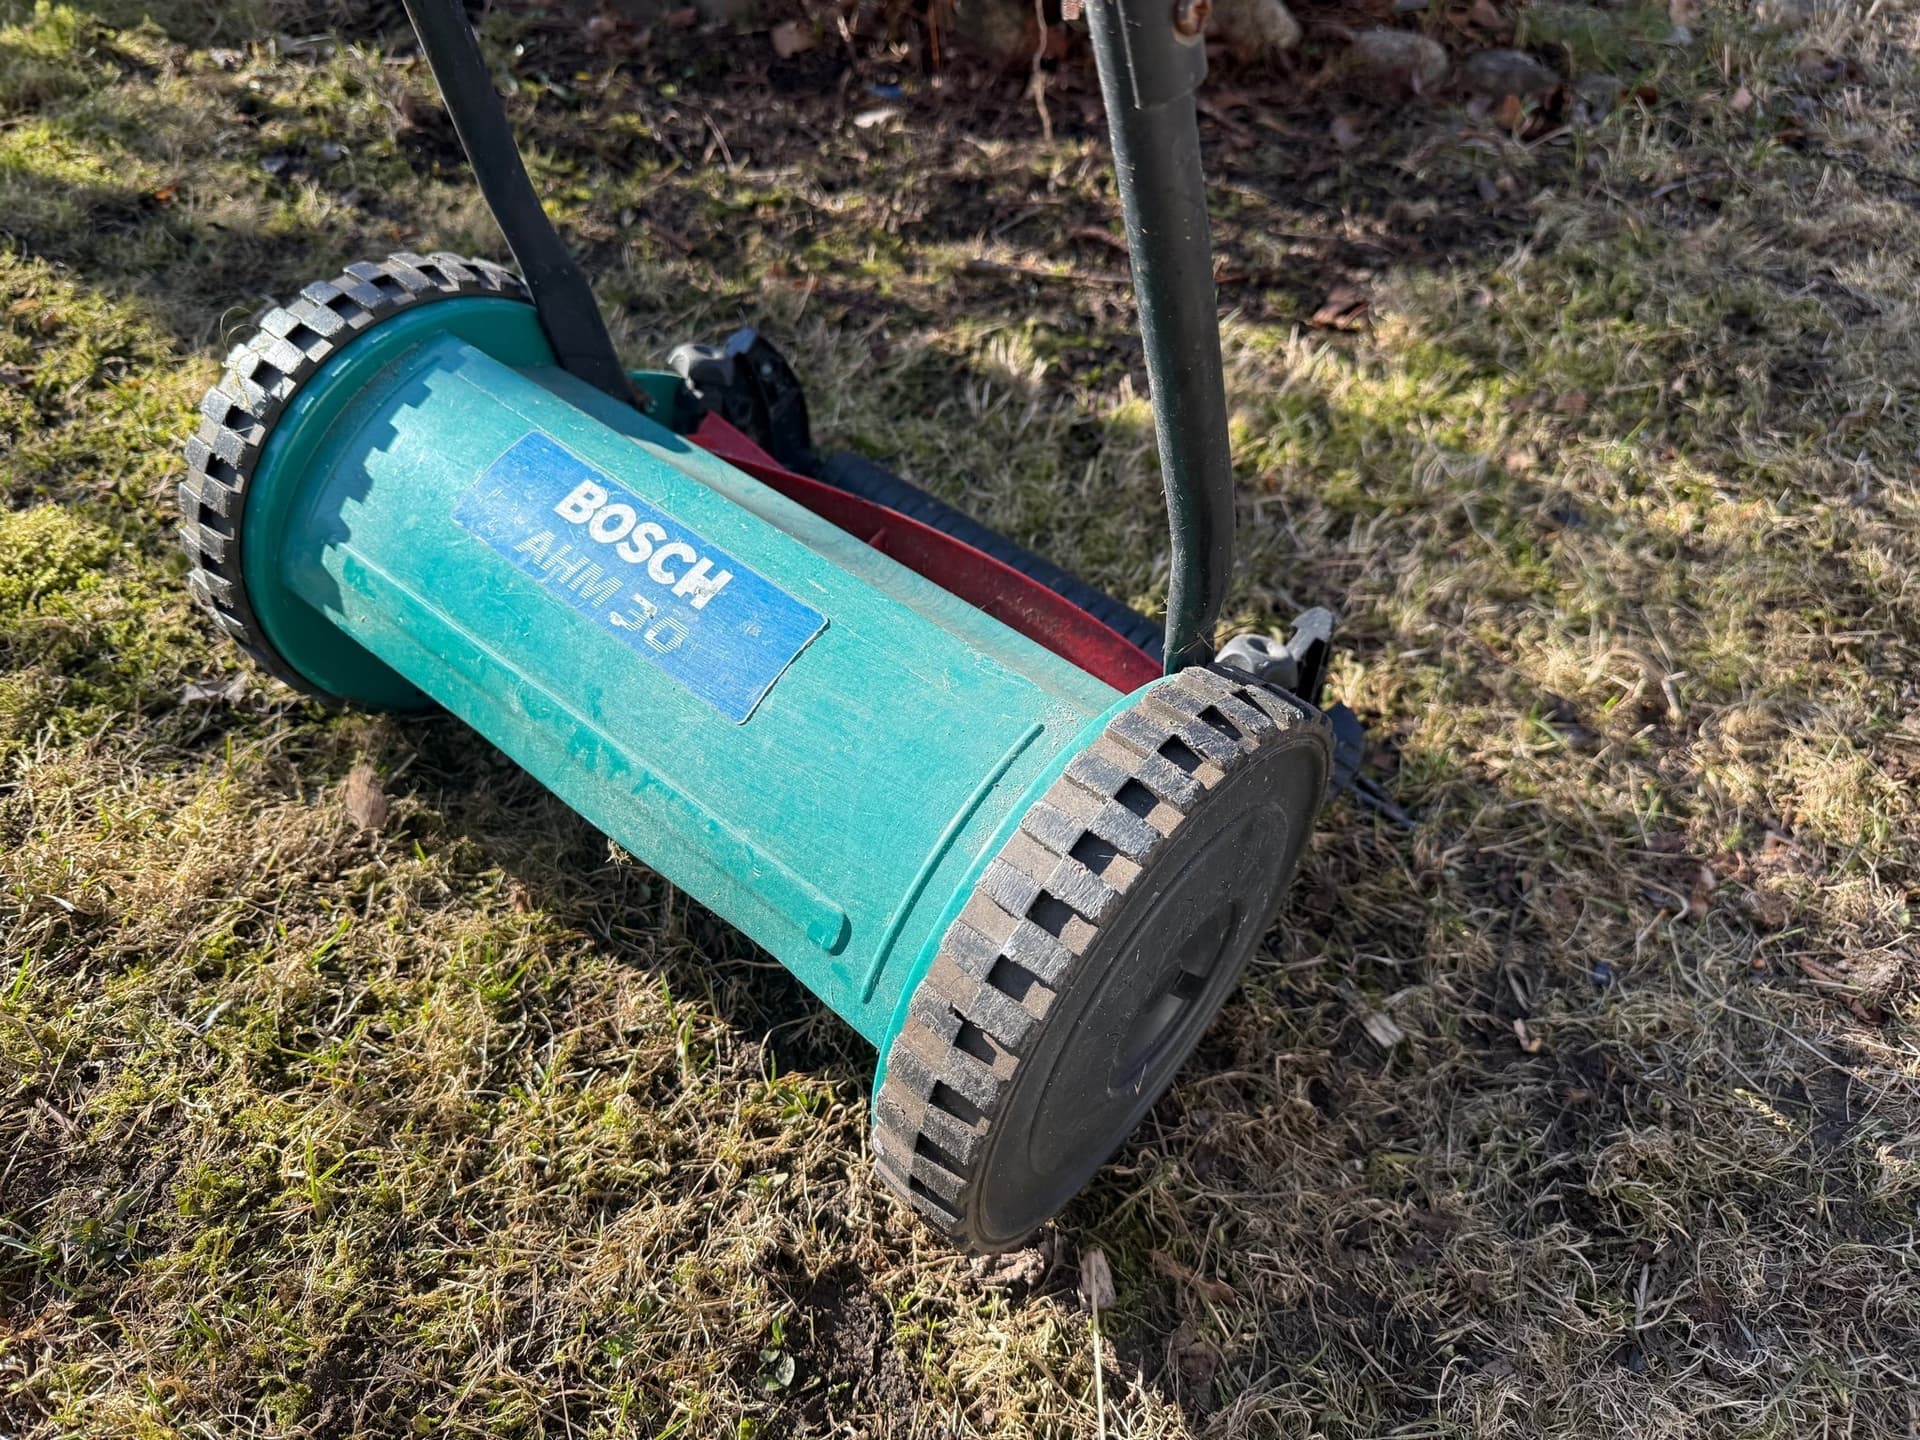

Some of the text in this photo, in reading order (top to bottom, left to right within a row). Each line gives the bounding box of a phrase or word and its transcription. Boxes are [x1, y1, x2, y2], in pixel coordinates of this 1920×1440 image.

[514, 530, 690, 654] AHM 30
[553, 479, 734, 610] BOSCH
